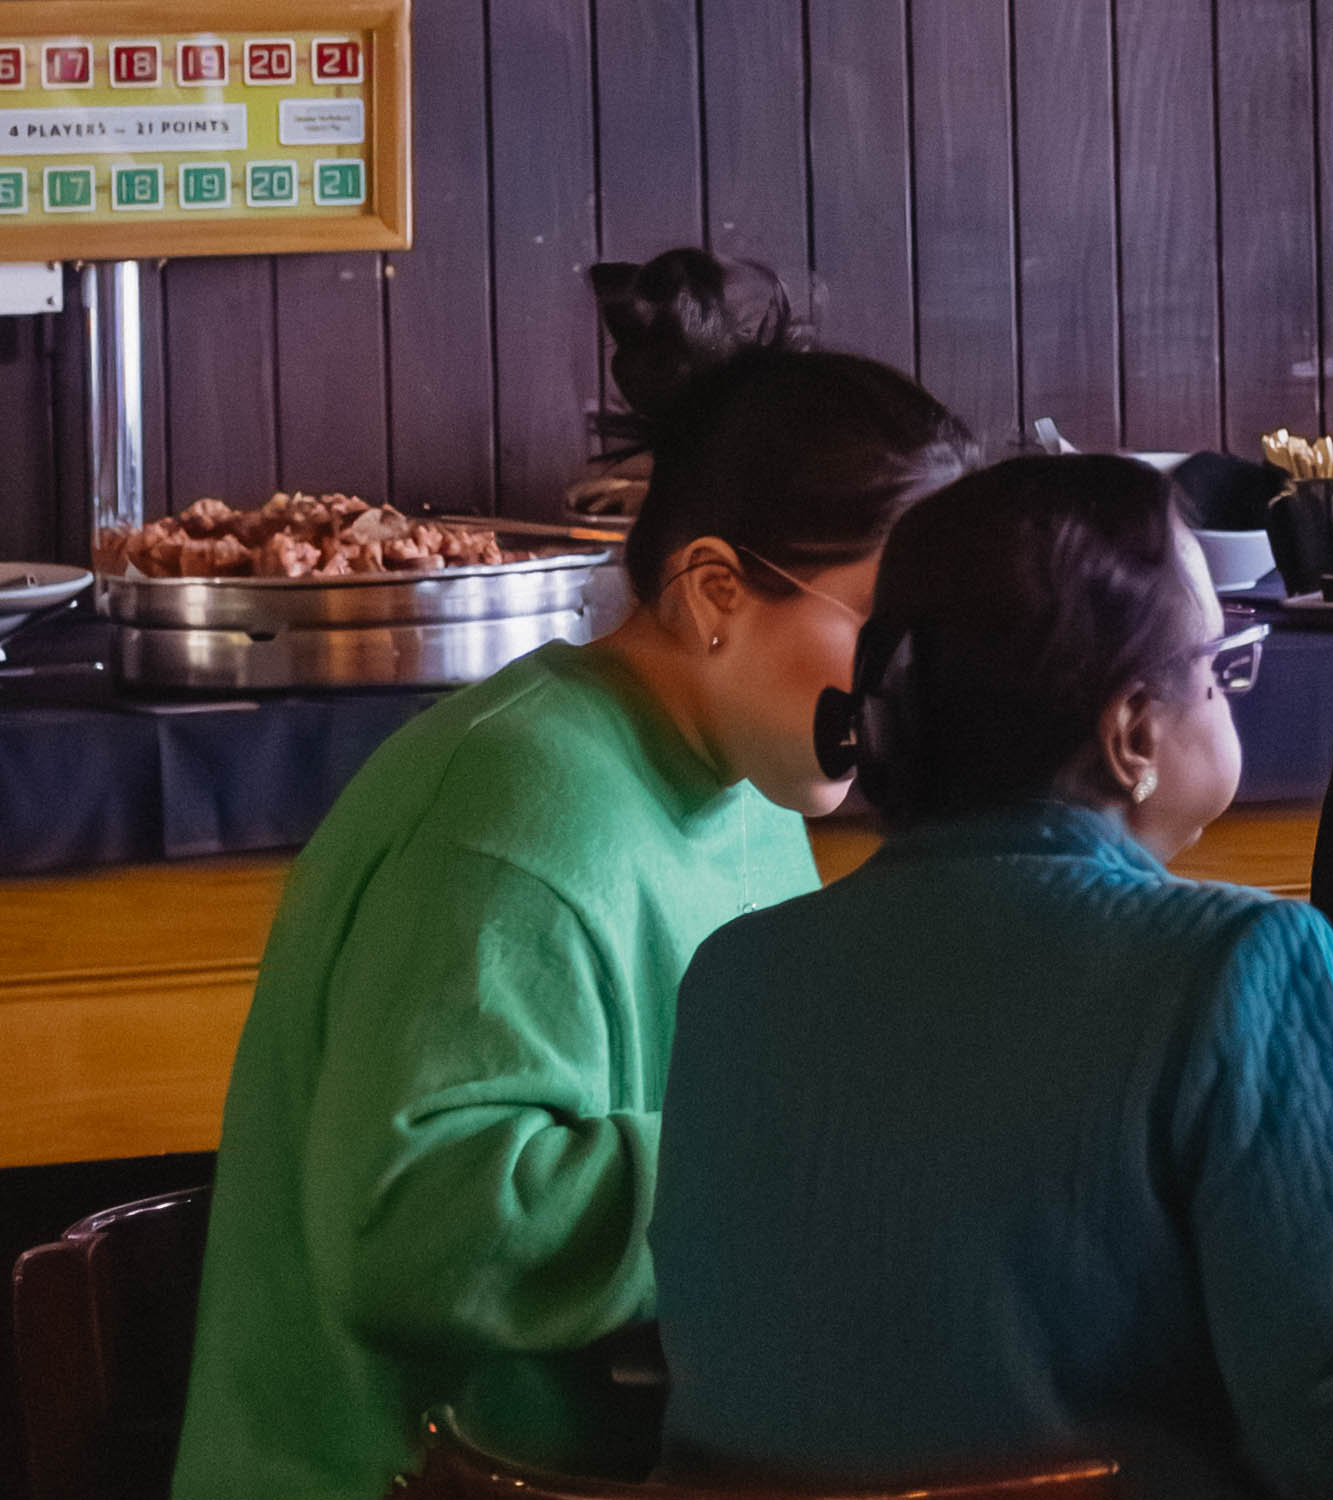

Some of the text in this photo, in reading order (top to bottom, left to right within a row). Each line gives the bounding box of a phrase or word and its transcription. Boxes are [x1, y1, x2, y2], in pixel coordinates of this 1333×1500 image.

[54, 53, 83, 79] 17
[120, 52, 151, 78] 18
[188, 49, 219, 77] 19
[251, 49, 290, 75] 20
[322, 47, 353, 74] 21
[9, 126, 19, 137] 4
[27, 122, 106, 138] PLAYERS
[137, 121, 153, 135] 21
[162, 119, 230, 134] POINTS
[55, 175, 85, 202] 17
[121, 174, 150, 202] 18
[188, 173, 219, 199] 19
[253, 171, 290, 197] 20
[323, 170, 353, 196] 21
